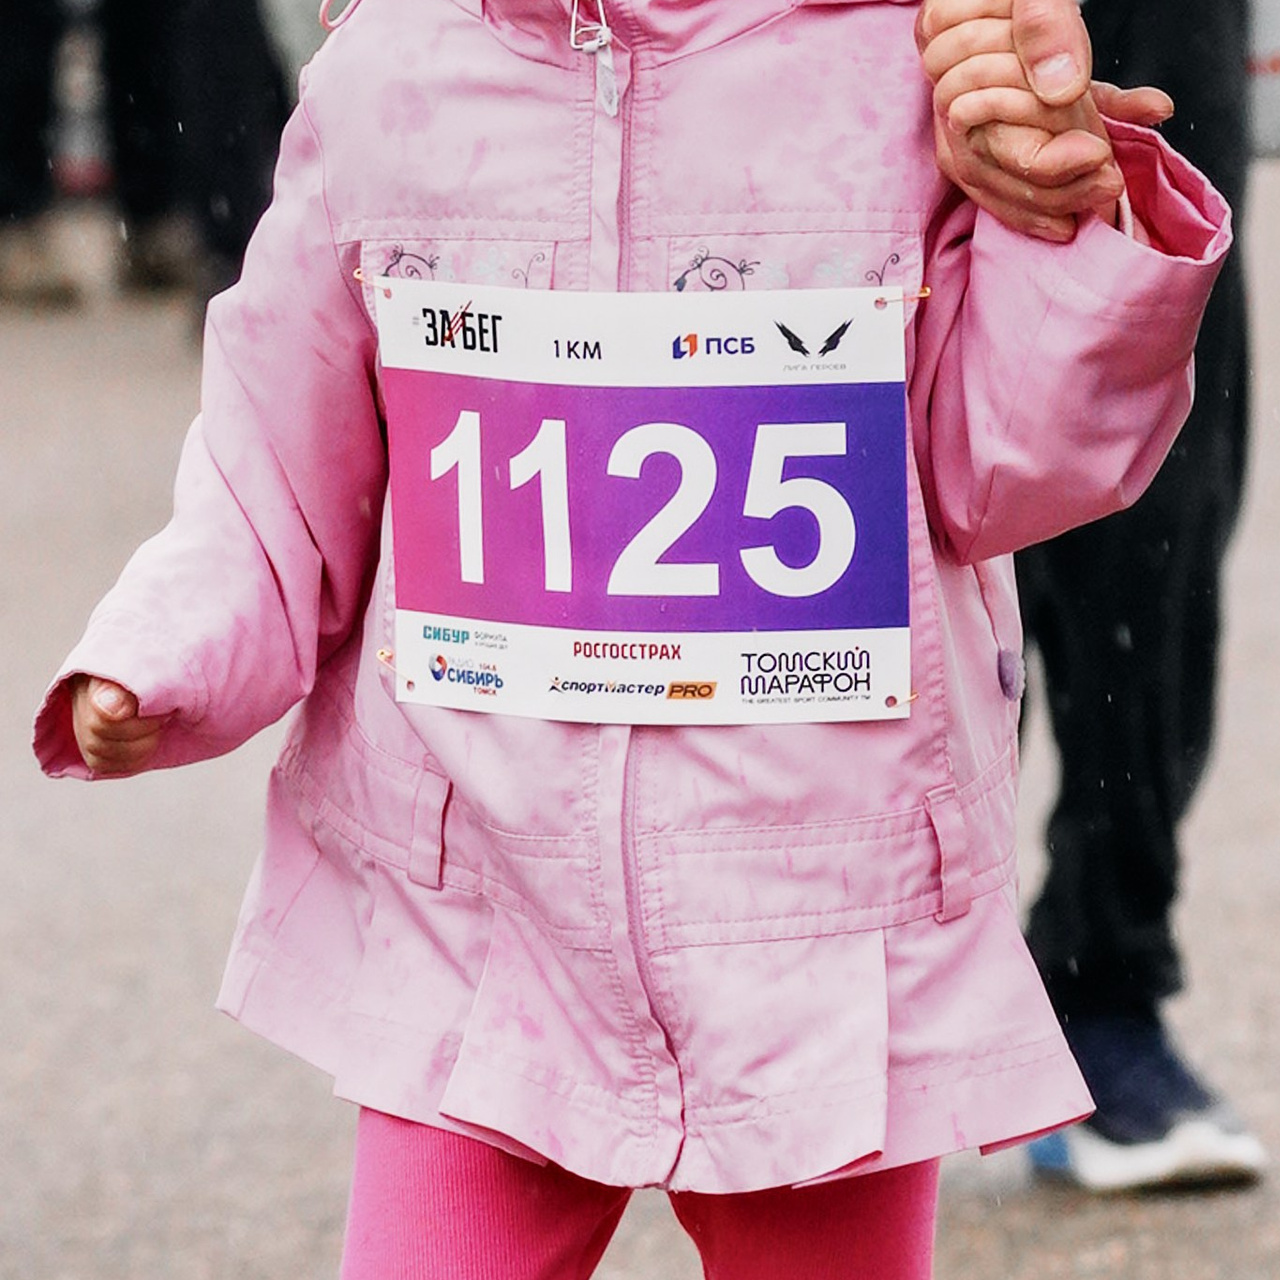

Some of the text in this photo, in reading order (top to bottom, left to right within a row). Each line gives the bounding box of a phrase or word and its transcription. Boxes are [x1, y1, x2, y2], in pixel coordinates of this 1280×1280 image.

[705, 336, 755, 355] ПСБ
[431, 410, 857, 597] 1125
[423, 625, 470, 644] СИБУР
[573, 641, 682, 660] РОСГОССТРАХ
[740, 646, 870, 673] ТОМСКИЙ
[447, 668, 504, 689] СИБИРЬ
[740, 672, 870, 695] МАРАФОН
[669, 684, 713, 698] PRO
